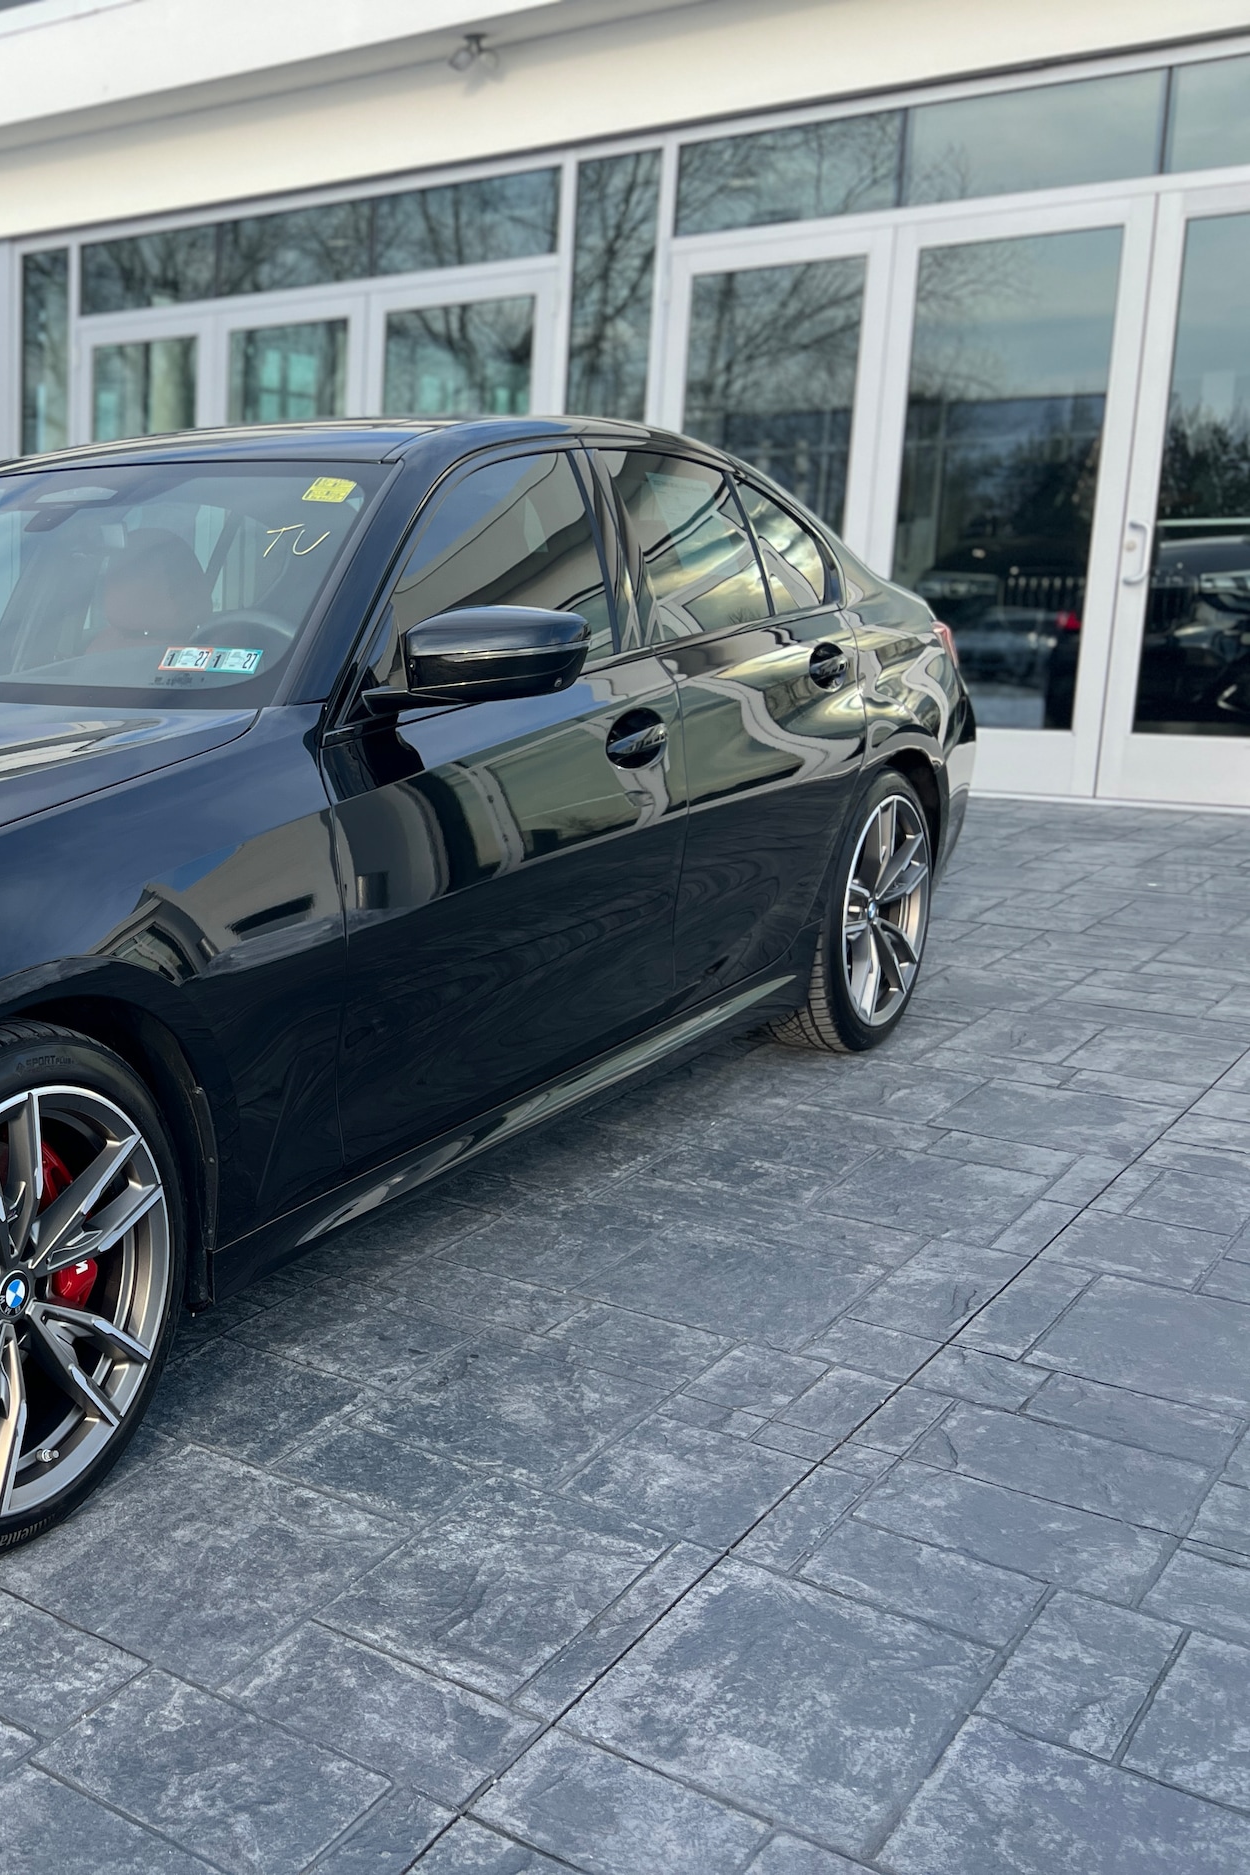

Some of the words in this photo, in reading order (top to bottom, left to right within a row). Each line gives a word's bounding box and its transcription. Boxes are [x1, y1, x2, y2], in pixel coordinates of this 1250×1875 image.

[263, 523, 330, 557] TU
[167, 652, 175, 666] 1
[194, 651, 210, 668] 27
[213, 654, 222, 668] 1
[242, 653, 258, 670] 27
[26, 1055, 55, 1066] SPORT
